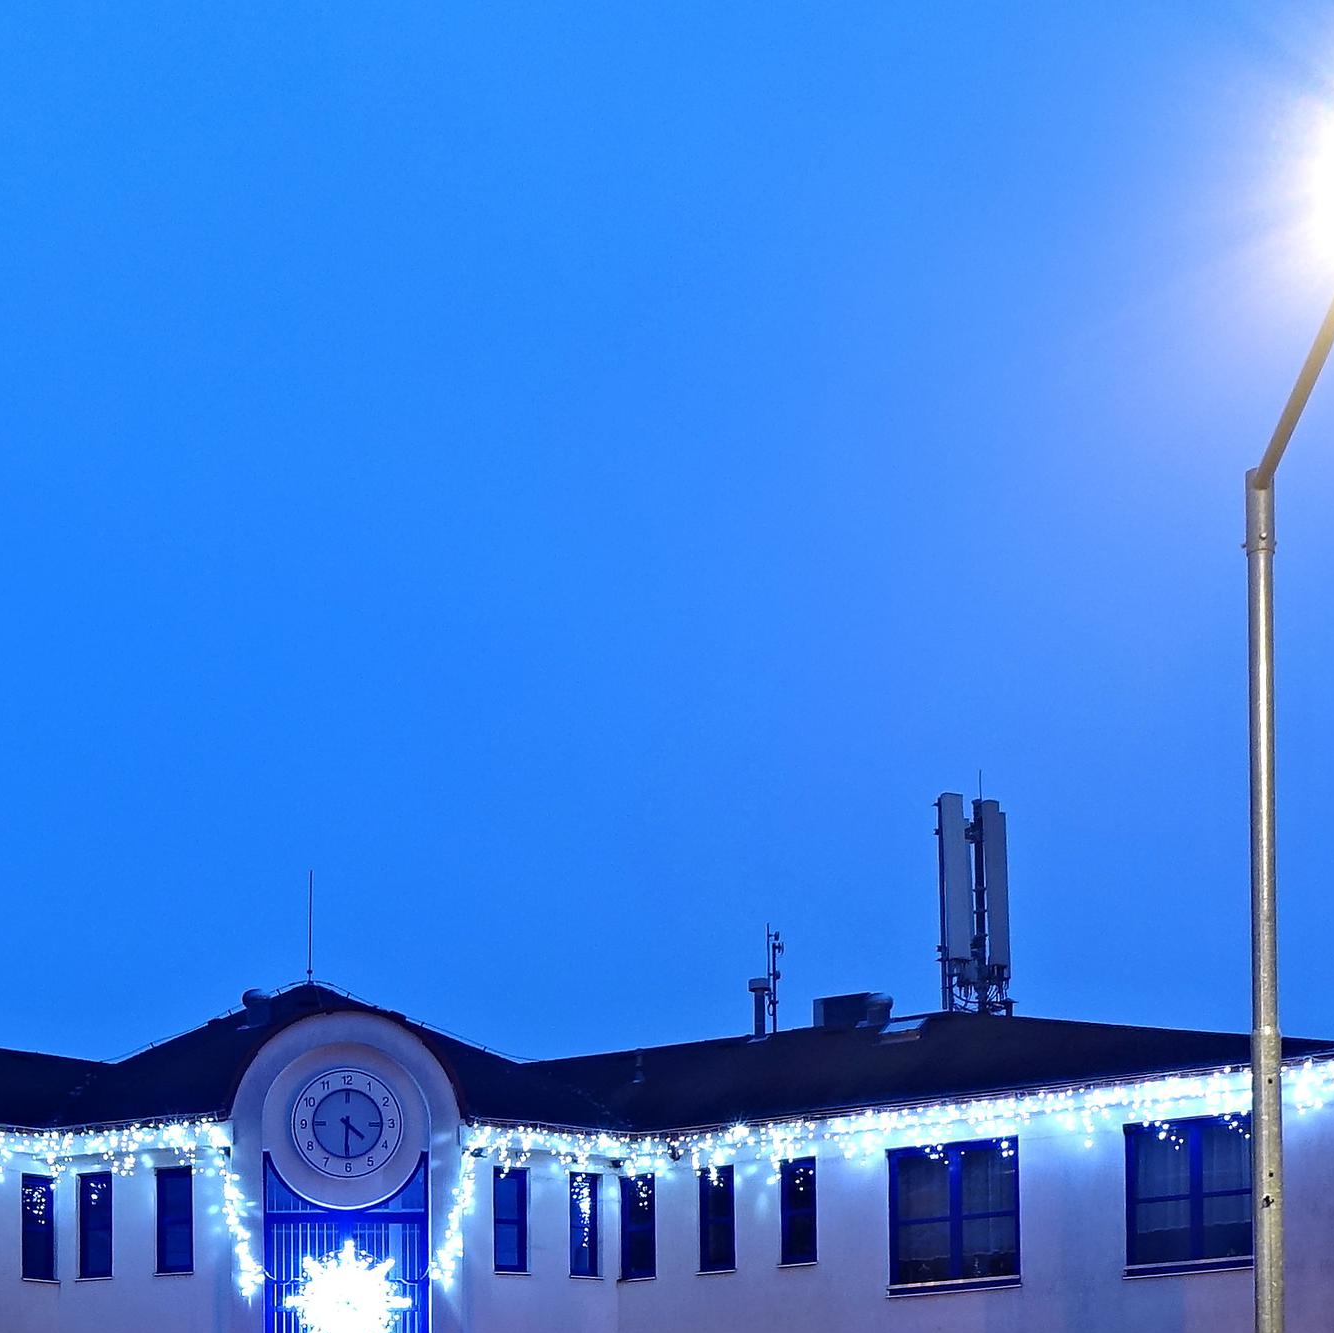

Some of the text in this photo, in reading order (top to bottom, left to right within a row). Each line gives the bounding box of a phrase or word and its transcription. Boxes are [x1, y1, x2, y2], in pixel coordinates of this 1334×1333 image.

[342, 1074, 353, 1085] 12
[321, 1080, 330, 1091] 11
[367, 1081, 371, 1091] 1
[304, 1096, 315, 1107] 10
[382, 1096, 390, 1107] 2
[300, 1118, 307, 1129] 9
[387, 1118, 395, 1129] 3
[307, 1140, 314, 1150] 8
[381, 1139, 388, 1150] 4
[323, 1156, 330, 1167] 7
[367, 1156, 374, 1167] 5
[345, 1162, 352, 1173] 6
